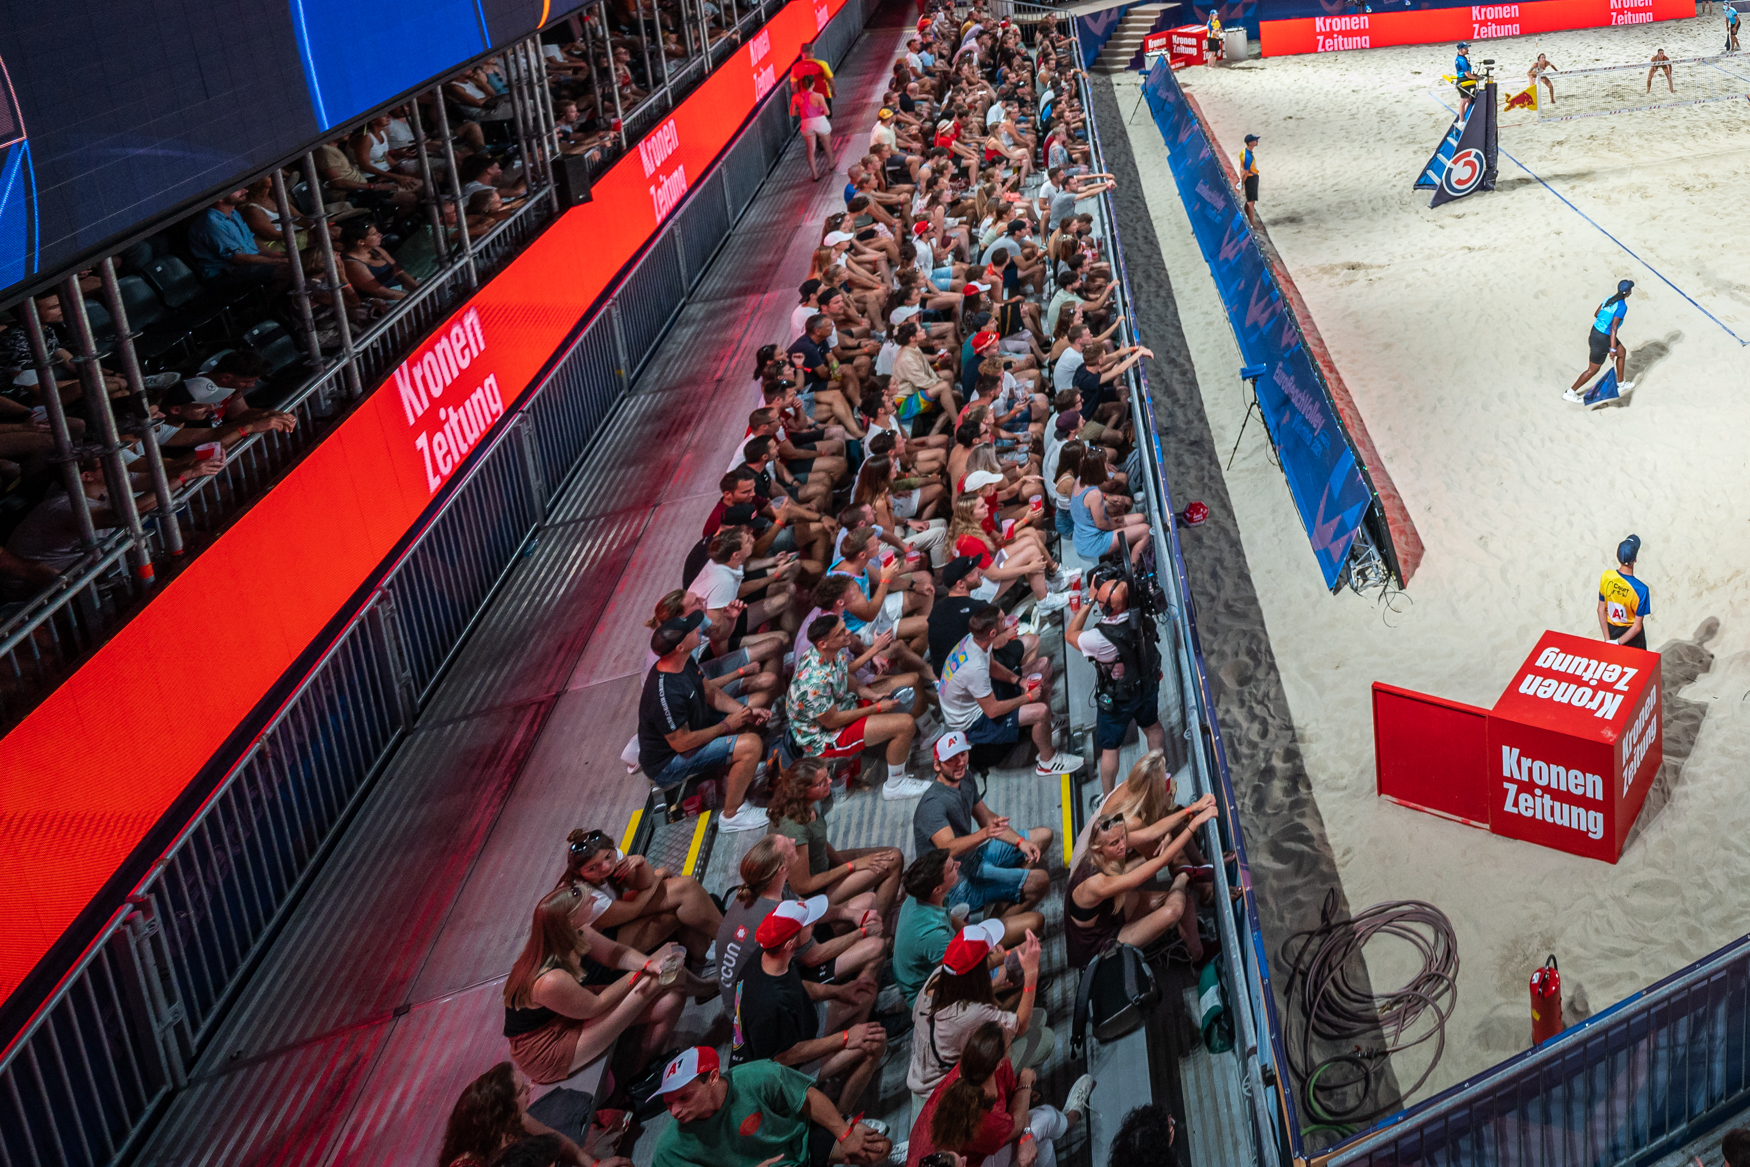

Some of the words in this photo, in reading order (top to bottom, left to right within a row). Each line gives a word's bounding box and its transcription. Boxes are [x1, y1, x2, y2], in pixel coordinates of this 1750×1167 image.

[1315, 15, 1369, 33] Kronen
[1471, 4, 1520, 21] Kronen
[1472, 22, 1520, 40] Zeitung
[1610, 11, 1654, 26] Zeitung
[1171, 34, 1197, 46] Kronen
[1172, 44, 1197, 56] Zeitung
[1316, 34, 1370, 53] Zeitung
[636, 116, 680, 179] Kronen
[648, 163, 688, 227] Zeitung
[393, 305, 488, 429] Kronen
[414, 370, 505, 496] Zeitung
[1534, 646, 1640, 692] Zeitung
[1517, 673, 1625, 721] Kronen
[948, 735, 968, 749] A1
[1621, 684, 1657, 769] Kronen
[1501, 744, 1604, 802] Kronen
[1621, 713, 1657, 800] Zeitung
[1502, 781, 1604, 840] Zeitung
[665, 1058, 685, 1080] A1
